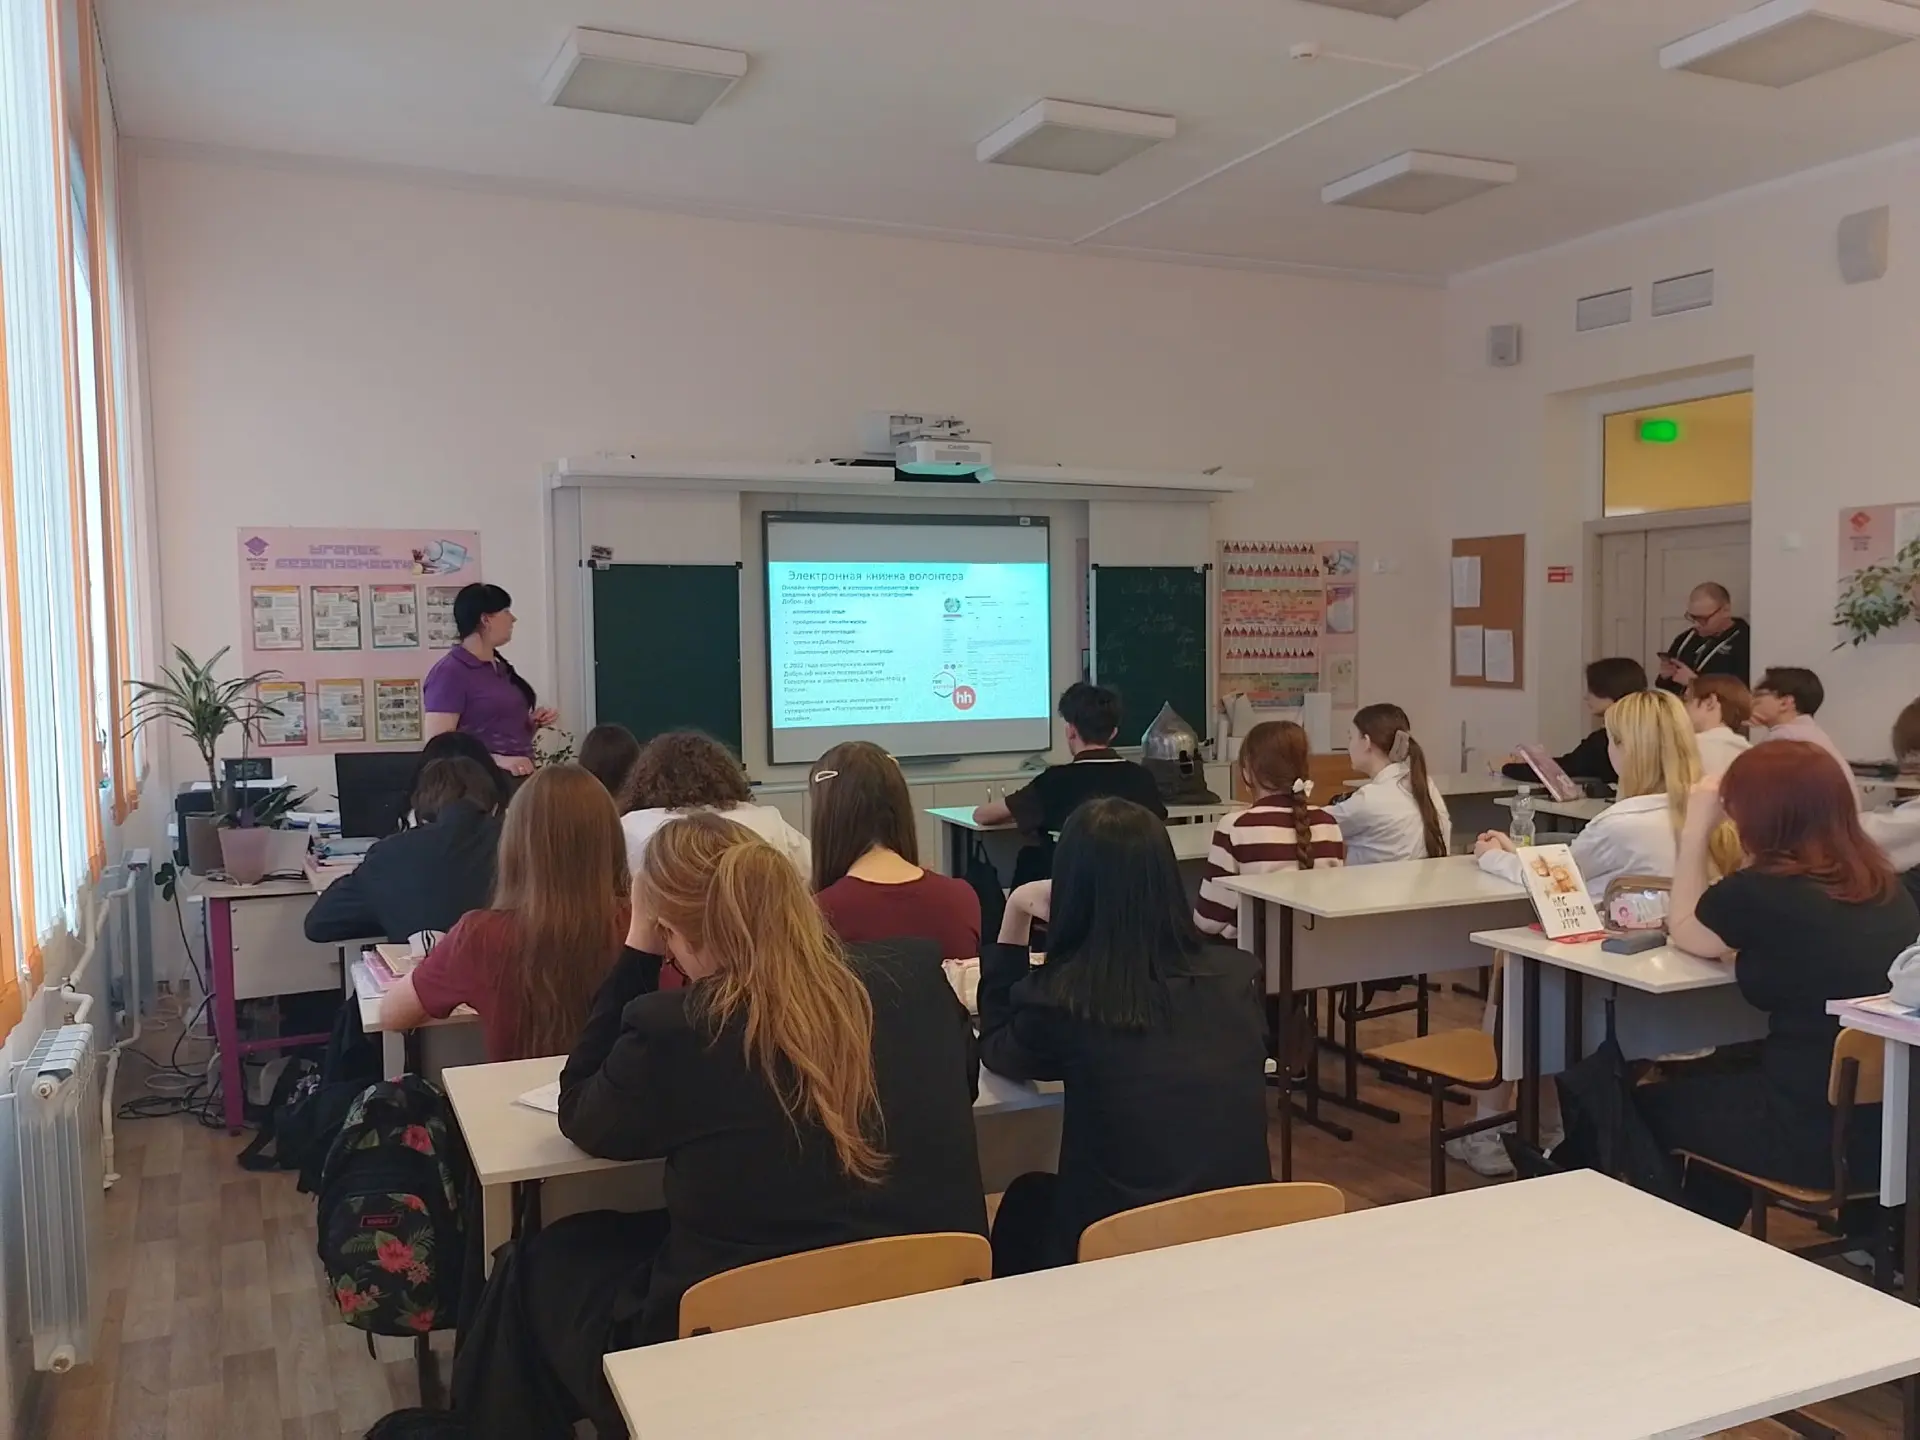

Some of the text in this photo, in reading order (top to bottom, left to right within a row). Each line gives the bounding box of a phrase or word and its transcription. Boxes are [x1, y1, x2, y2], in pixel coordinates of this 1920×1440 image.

[788, 570, 964, 583] Электронная книжка волонтера
[956, 691, 973, 704] hh
